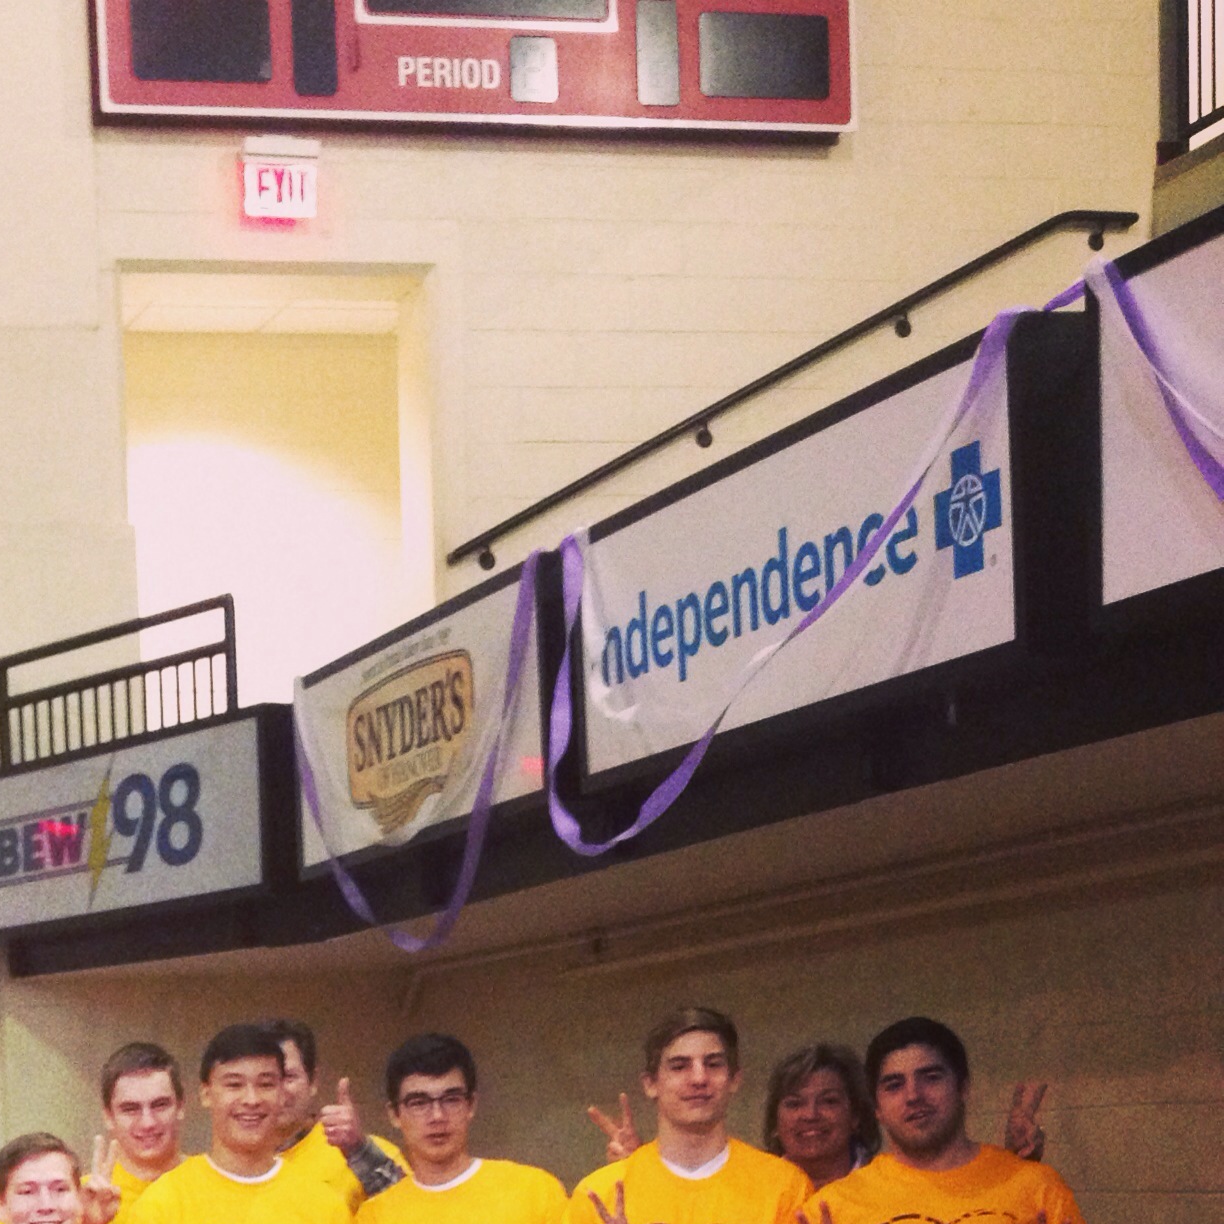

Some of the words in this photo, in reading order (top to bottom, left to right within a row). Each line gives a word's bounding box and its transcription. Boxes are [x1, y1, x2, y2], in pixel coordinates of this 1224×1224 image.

[398, 56, 501, 89] PERIOD
[601, 506, 918, 687] ndependence
[353, 667, 466, 773] SNYDER'S
[112, 761, 204, 875] 98
